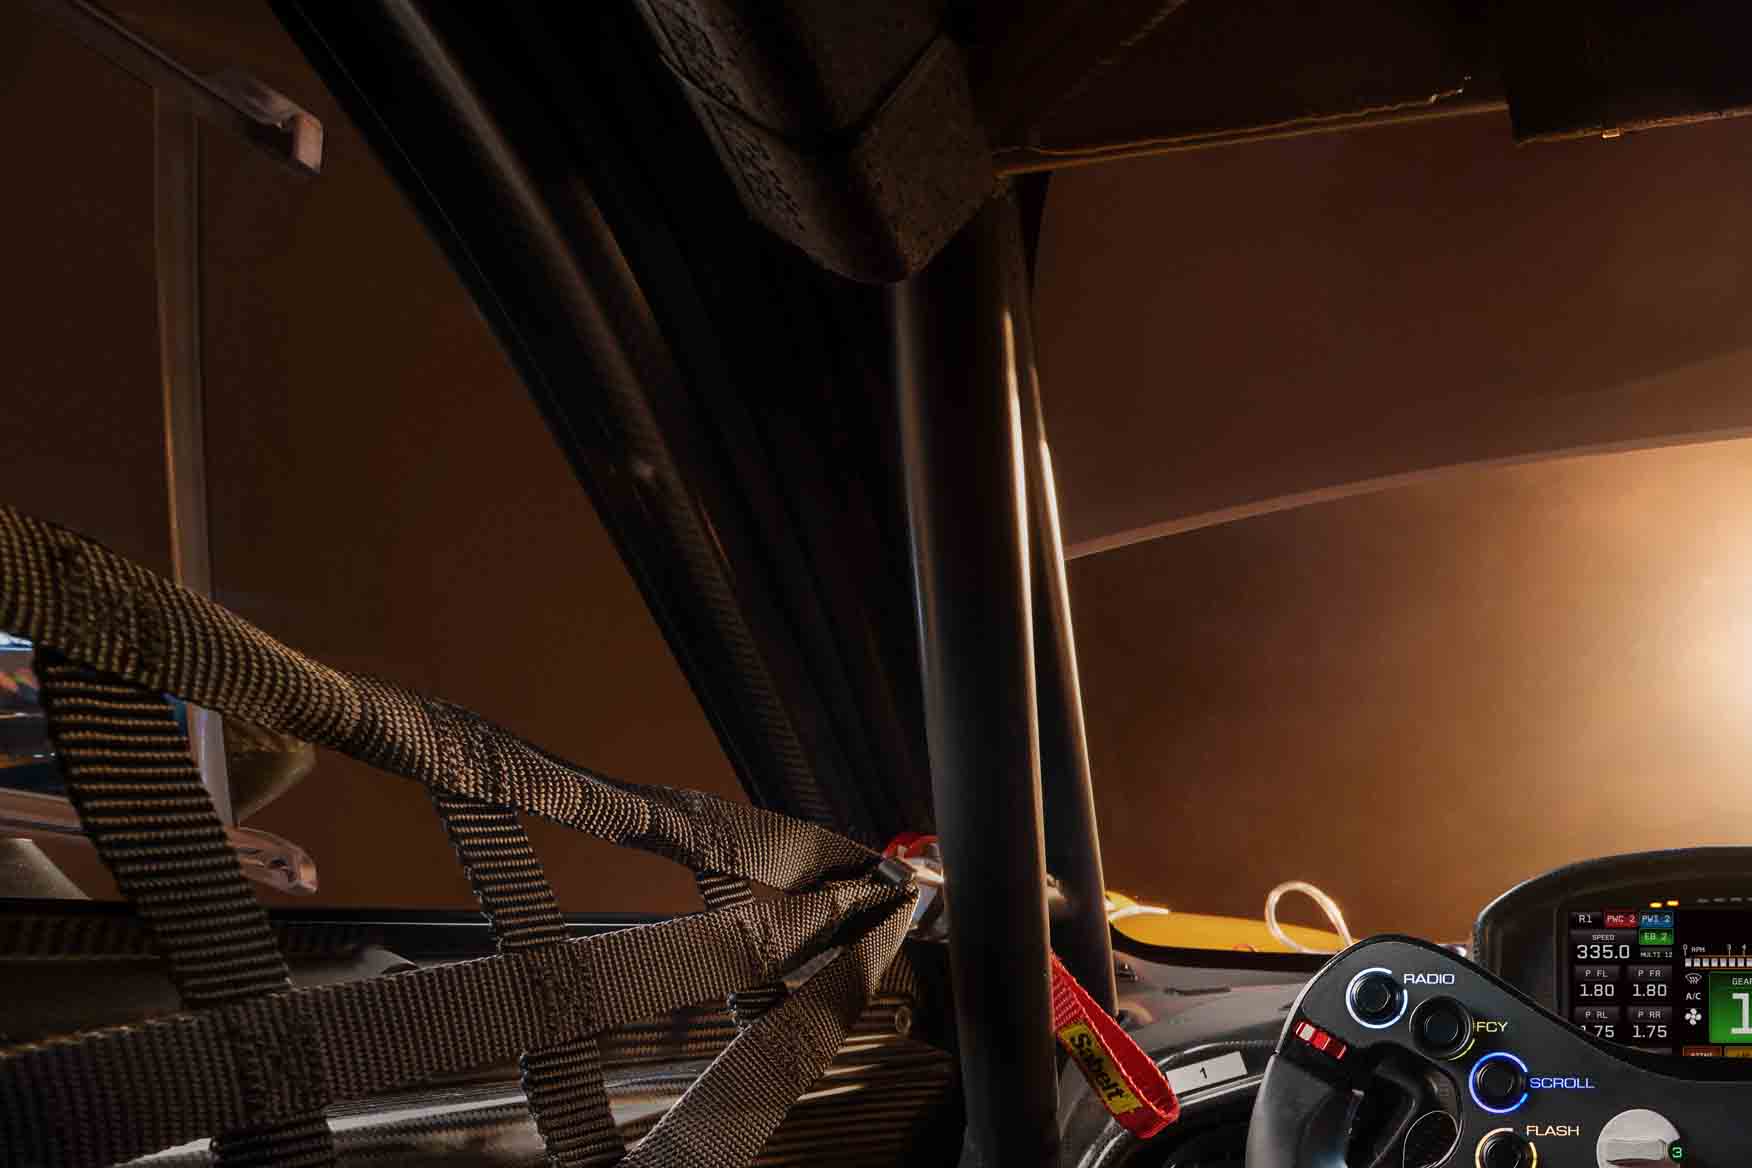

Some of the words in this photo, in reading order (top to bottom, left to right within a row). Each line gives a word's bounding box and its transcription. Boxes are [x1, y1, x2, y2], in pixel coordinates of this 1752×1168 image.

[1578, 914, 1592, 924] R1
[1577, 944, 1630, 959] 335.0
[1402, 973, 1455, 985] RADIO
[1580, 983, 1615, 997] 1.80
[1632, 983, 1667, 997] 1.80
[1686, 992, 1701, 1000] A/C
[1476, 1021, 1508, 1033] FCY
[1632, 1025, 1667, 1038] 1.75
[1070, 1032, 1125, 1101] Sabelt
[1200, 1067, 1208, 1079] 1
[1530, 1077, 1595, 1089] SCROLL
[1526, 1125, 1579, 1137] FLASH
[1672, 1147, 1682, 1158] 3
